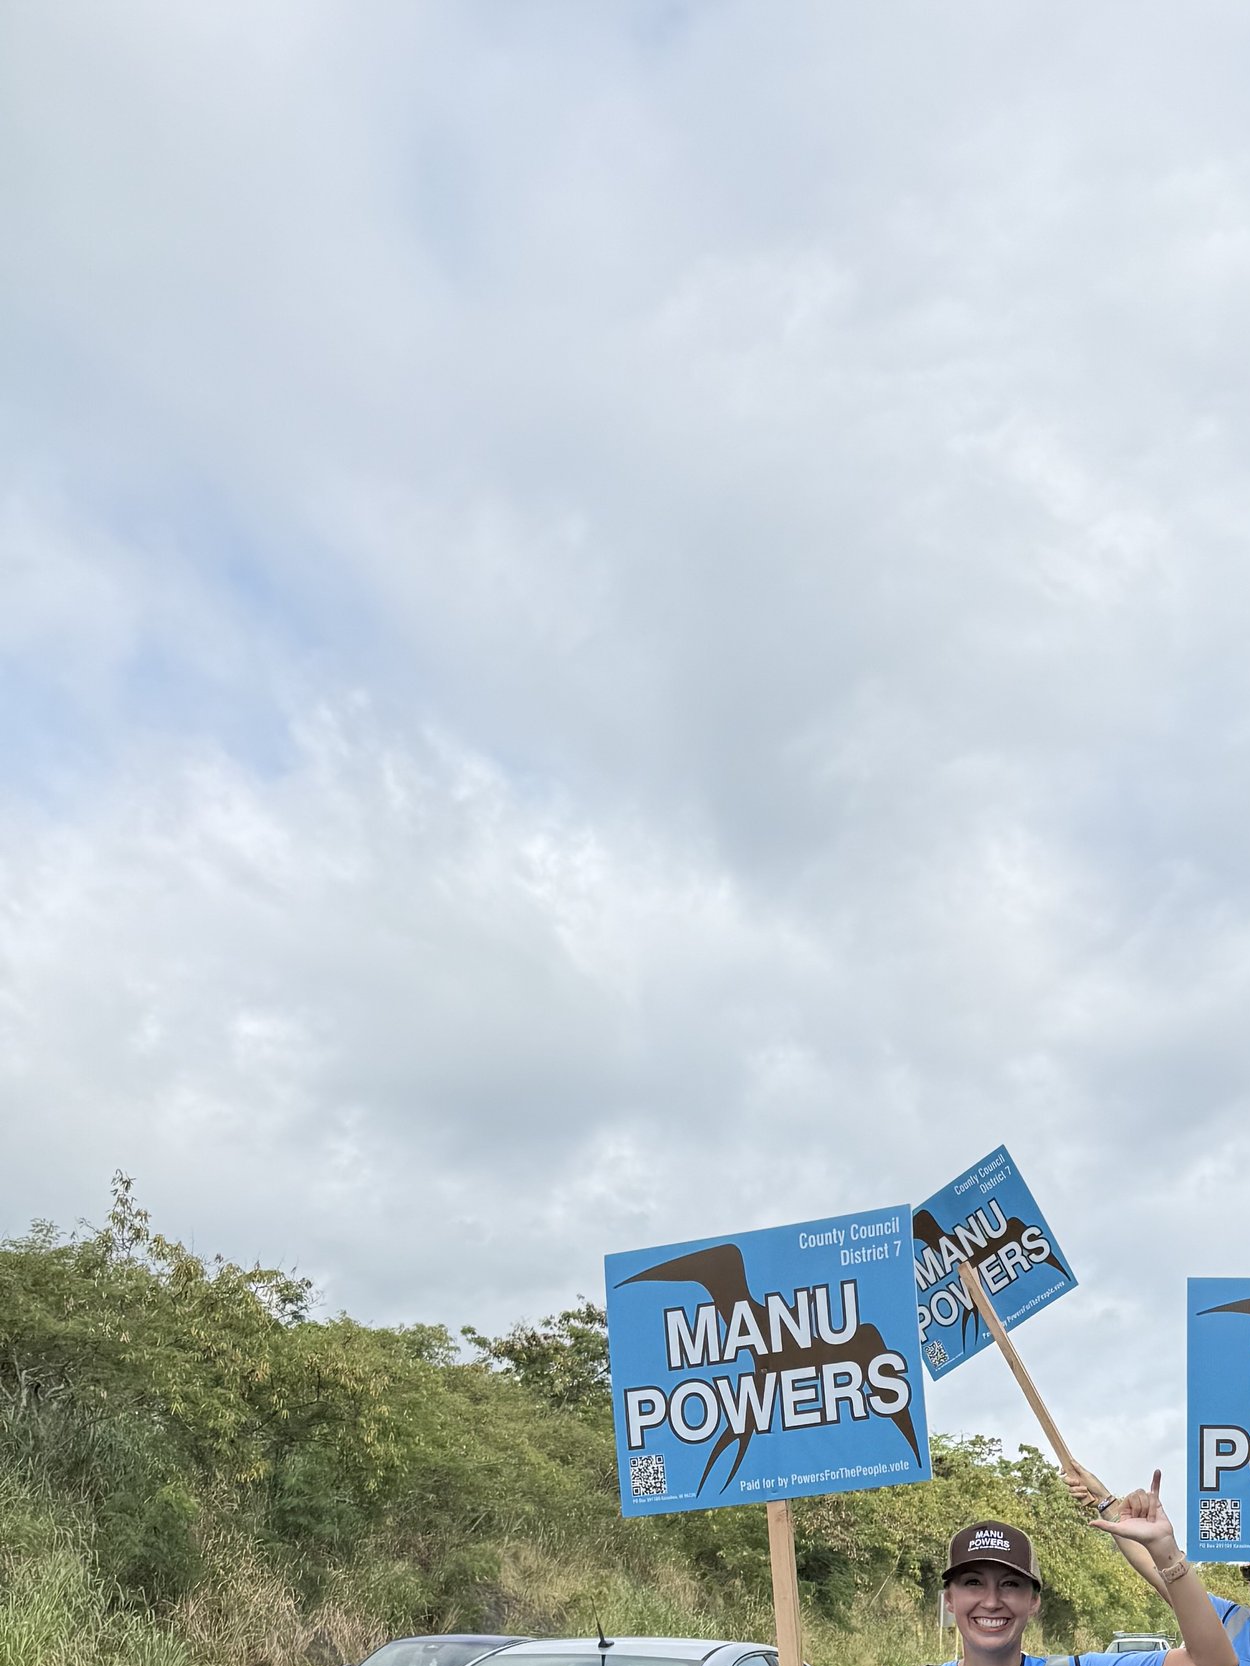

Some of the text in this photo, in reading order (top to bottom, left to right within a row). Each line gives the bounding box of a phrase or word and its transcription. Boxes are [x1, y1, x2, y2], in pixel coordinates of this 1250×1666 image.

[953, 1153, 1006, 1196] County Council
[979, 1166, 1013, 1194] District 7
[799, 1217, 901, 1251] County Council
[914, 1197, 1008, 1292] MANU
[840, 1241, 903, 1267] District 7
[664, 1280, 860, 1372] MANU
[624, 1349, 912, 1451] POWERS
[739, 1460, 910, 1493] Paid for by PowersForThePeople.vote
[969, 1538, 1010, 1549] POWERS
[975, 1530, 1004, 1539] MANU
